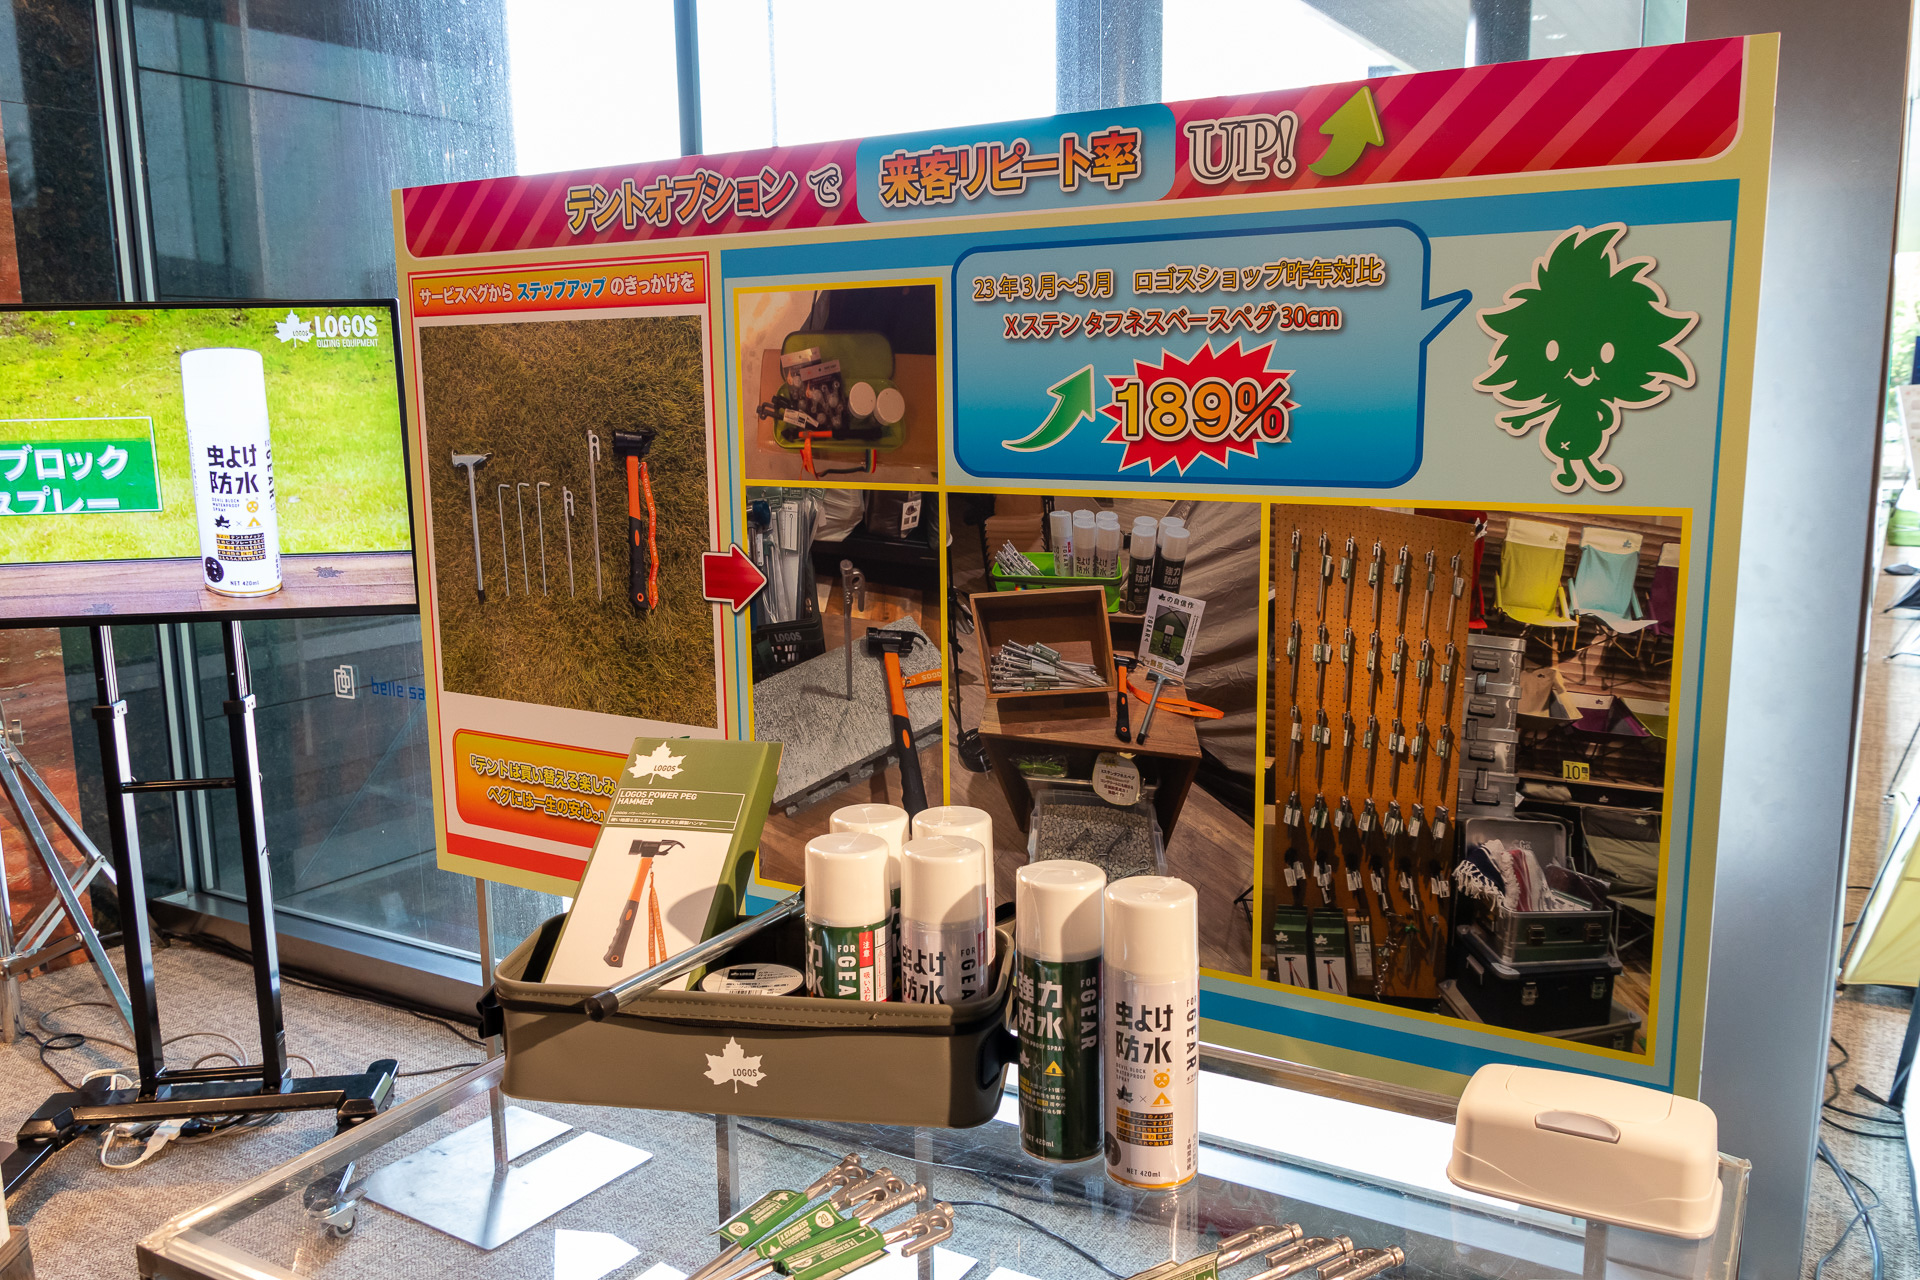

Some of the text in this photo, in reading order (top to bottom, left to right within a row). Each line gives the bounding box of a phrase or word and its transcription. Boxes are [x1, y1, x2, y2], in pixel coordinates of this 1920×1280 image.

[566, 110, 1299, 235] テントオプション で 来客リピート率 UP!
[1134, 257, 1384, 293] ロゴスショップ昨年対比
[314, 315, 379, 338] LOGOS
[1114, 380, 1289, 440] 189%
[206, 444, 257, 468] 虫よけ
[209, 471, 259, 495] 防水
[774, 632, 802, 643] LOGOS
[371, 676, 404, 697] belle
[653, 764, 677, 772] LOGOS
[1565, 764, 1580, 780] 10
[617, 798, 655, 806] HAMMER
[619, 790, 648, 798] LOGOS
[648, 791, 679, 800] POWER
[837, 945, 856, 953] FOR
[862, 941, 871, 958] 注意
[961, 947, 976, 957] FOR
[903, 945, 947, 977] 虫よけ
[903, 970, 946, 1005] 防水
[1019, 971, 1063, 1009] 強力
[1080, 976, 1097, 988] FOR
[1019, 1000, 1065, 1040] 防水
[1080, 989, 1097, 1050] GEAR
[1115, 1000, 1174, 1033] 虫よけ
[1115, 1030, 1172, 1064] 防水
[1186, 1008, 1197, 1072] GEAR
[732, 1068, 757, 1077] LOGOS
[1126, 1167, 1138, 1175] NET
[817, 1213, 829, 1224] 20
